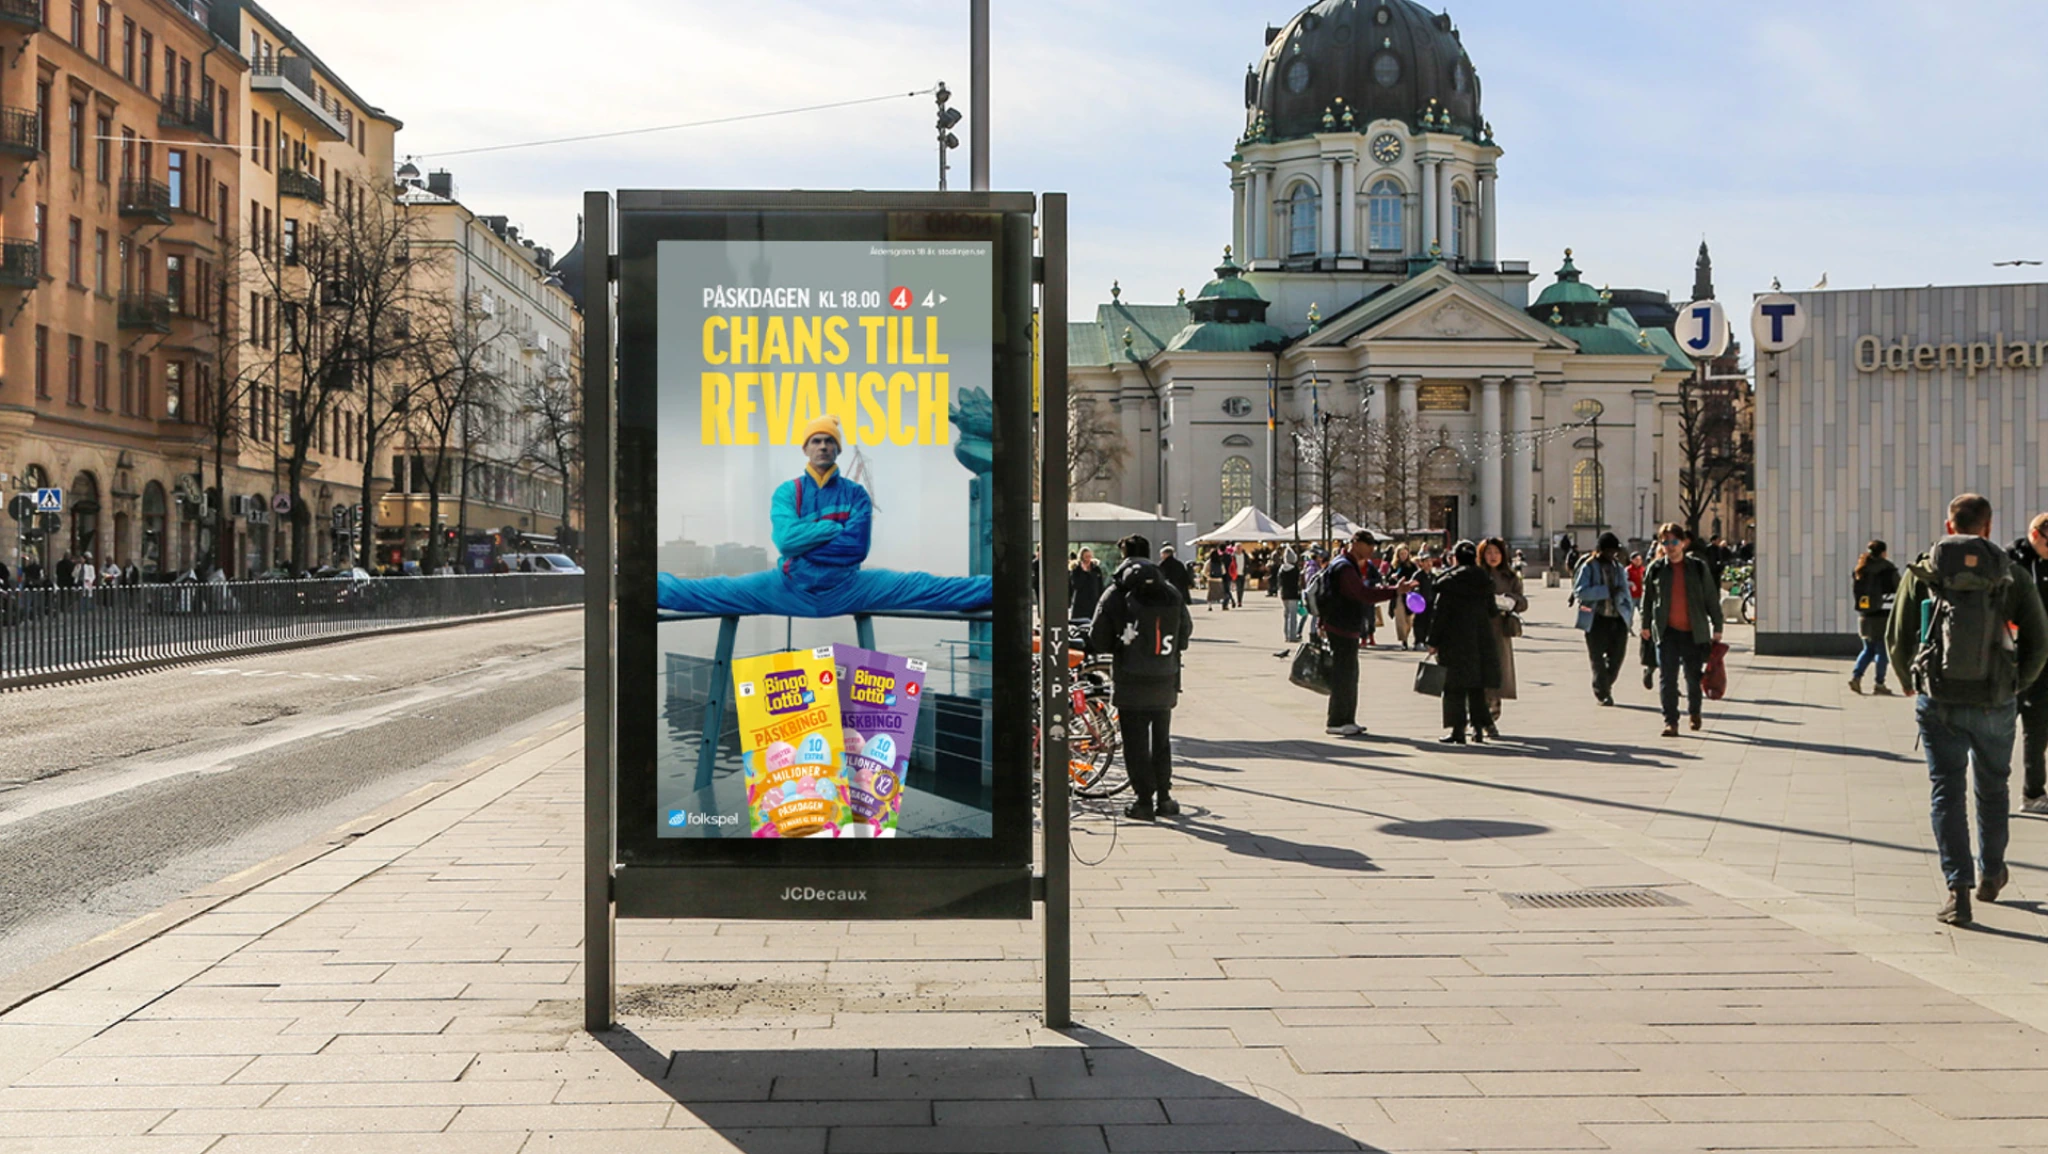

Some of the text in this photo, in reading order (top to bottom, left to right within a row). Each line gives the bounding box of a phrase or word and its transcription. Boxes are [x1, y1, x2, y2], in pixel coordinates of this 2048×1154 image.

[702, 284, 811, 309] PÅSKDAGEN
[818, 290, 838, 309] KL
[840, 290, 881, 309] 18.00
[1686, 307, 1711, 350] J
[1761, 304, 1796, 343] T
[702, 314, 949, 365] CHANS TILL
[701, 370, 949, 447] REVANSCH
[764, 674, 808, 694] Bingo
[854, 669, 896, 692] Bingo
[764, 691, 803, 712] Lotto
[850, 685, 885, 705] Lotto
[754, 709, 828, 747] PÅSKBINGO
[842, 713, 902, 729] ÅSKBINGO
[808, 738, 823, 752] 10
[870, 748, 889, 761] EXTRA
[876, 738, 891, 753] 10
[804, 752, 824, 761] EXTRA
[846, 755, 882, 772] ILJONER
[772, 765, 821, 783] MILJONER
[876, 775, 892, 795] X2
[687, 812, 739, 827] folkspel
[780, 887, 868, 901] JCDecaux
